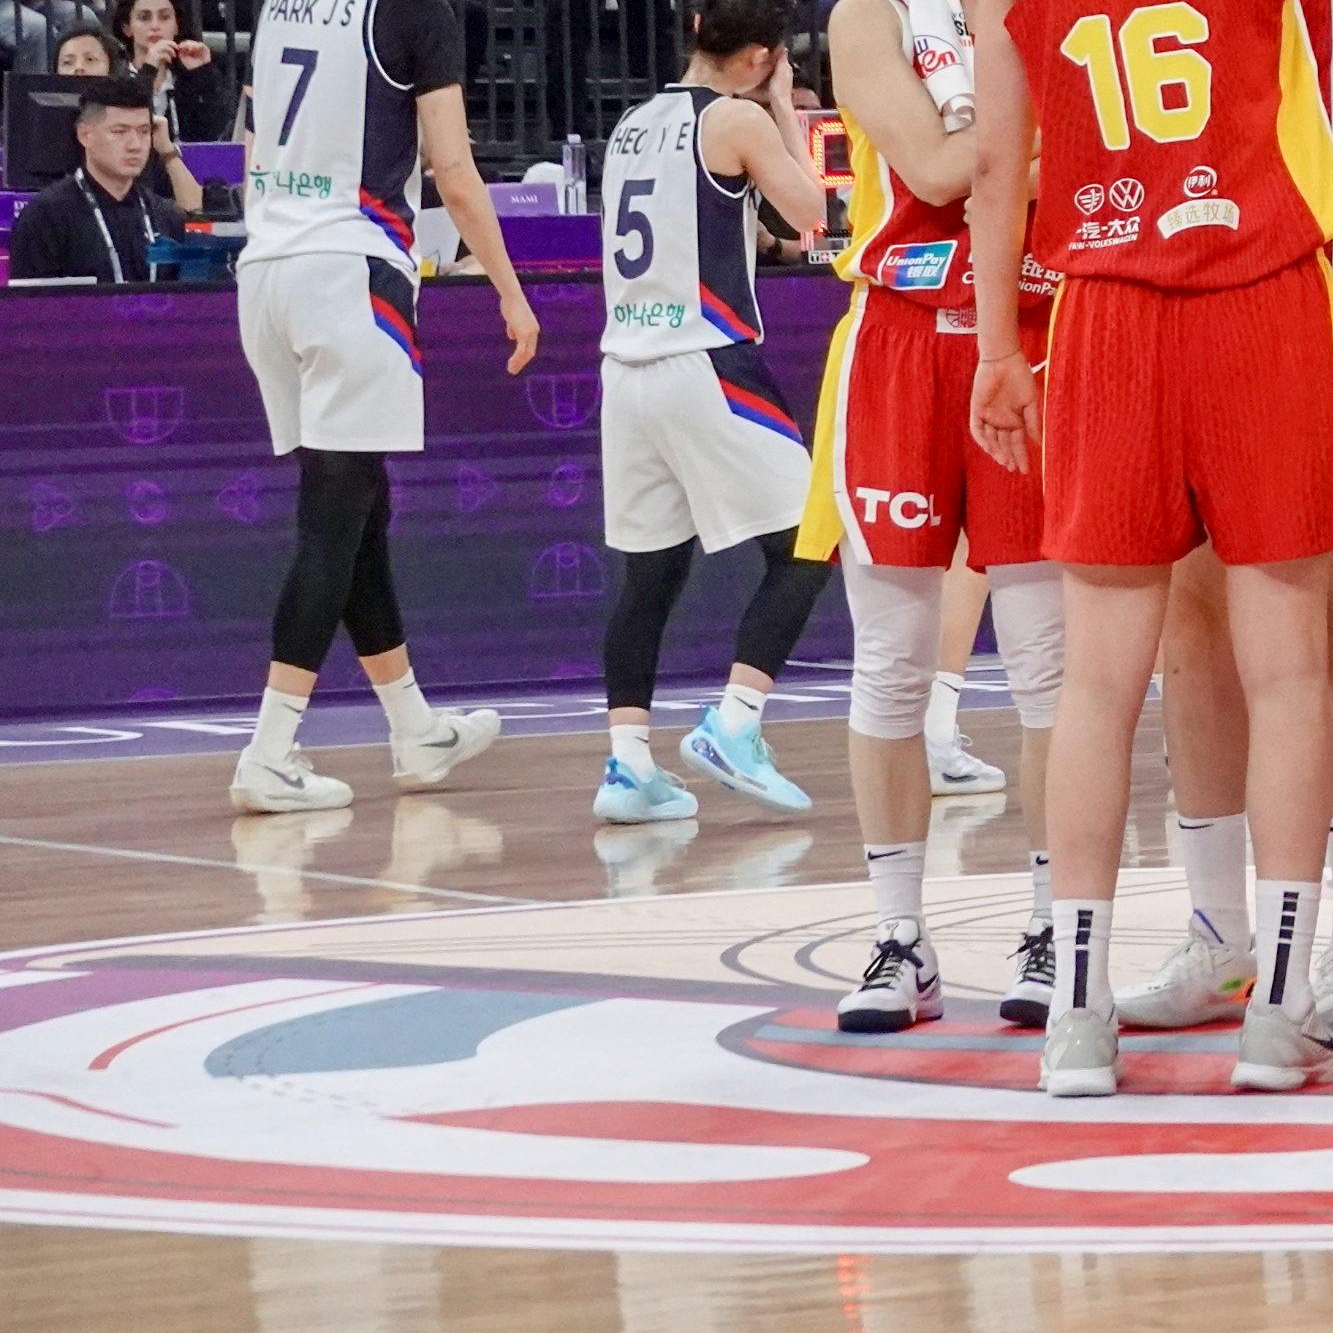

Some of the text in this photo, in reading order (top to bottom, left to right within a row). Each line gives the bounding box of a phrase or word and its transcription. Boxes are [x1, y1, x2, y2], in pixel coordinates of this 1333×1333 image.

[341, 0, 355, 27] S
[955, 21, 970, 37] SI
[1060, 1, 1212, 150] 16
[278, 46, 319, 147] 7
[676, 122, 691, 151] E
[614, 178, 656, 280] 5
[886, 252, 947, 270] UnionPay
[906, 266, 940, 279] 银联
[614, 302, 685, 329] 하나은행
[856, 487, 942, 529] TCL
